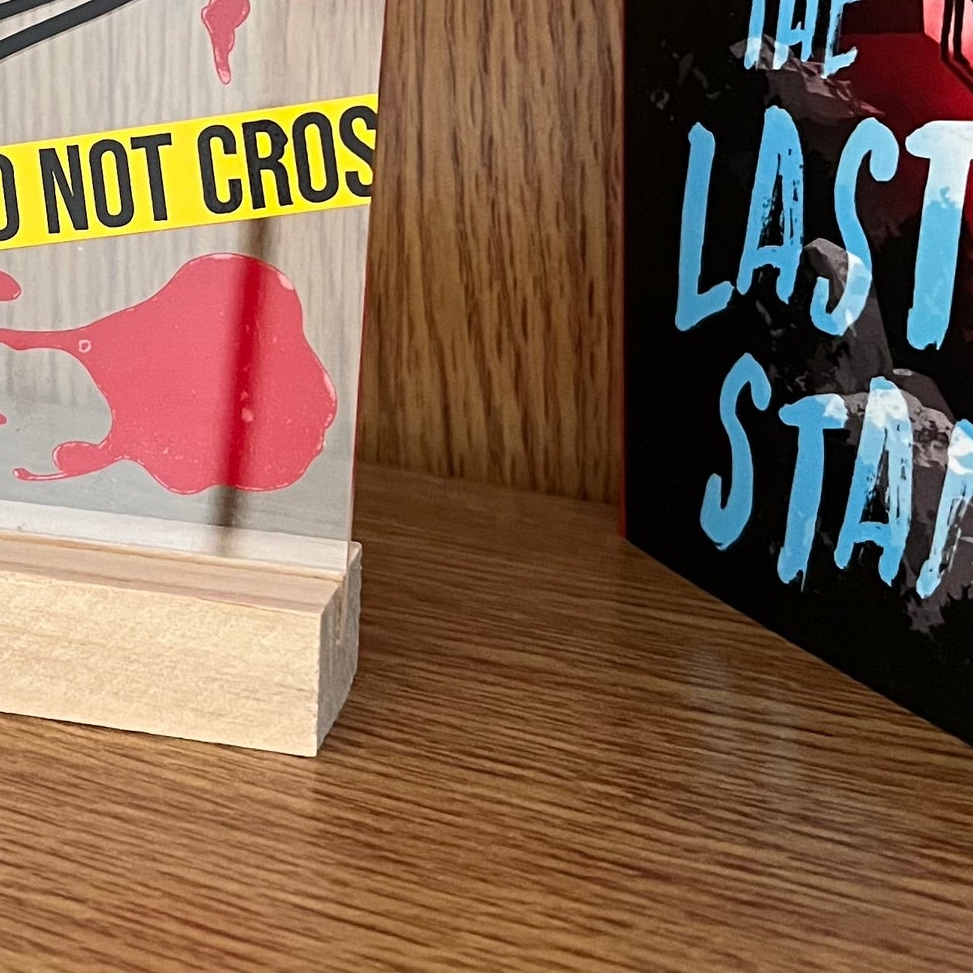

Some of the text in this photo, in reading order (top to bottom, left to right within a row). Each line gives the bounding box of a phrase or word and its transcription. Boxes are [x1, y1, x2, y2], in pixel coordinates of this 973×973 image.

[38, 131, 174, 231] NOT
[197, 105, 378, 215] CROS
[674, 104, 973, 352] LAST
